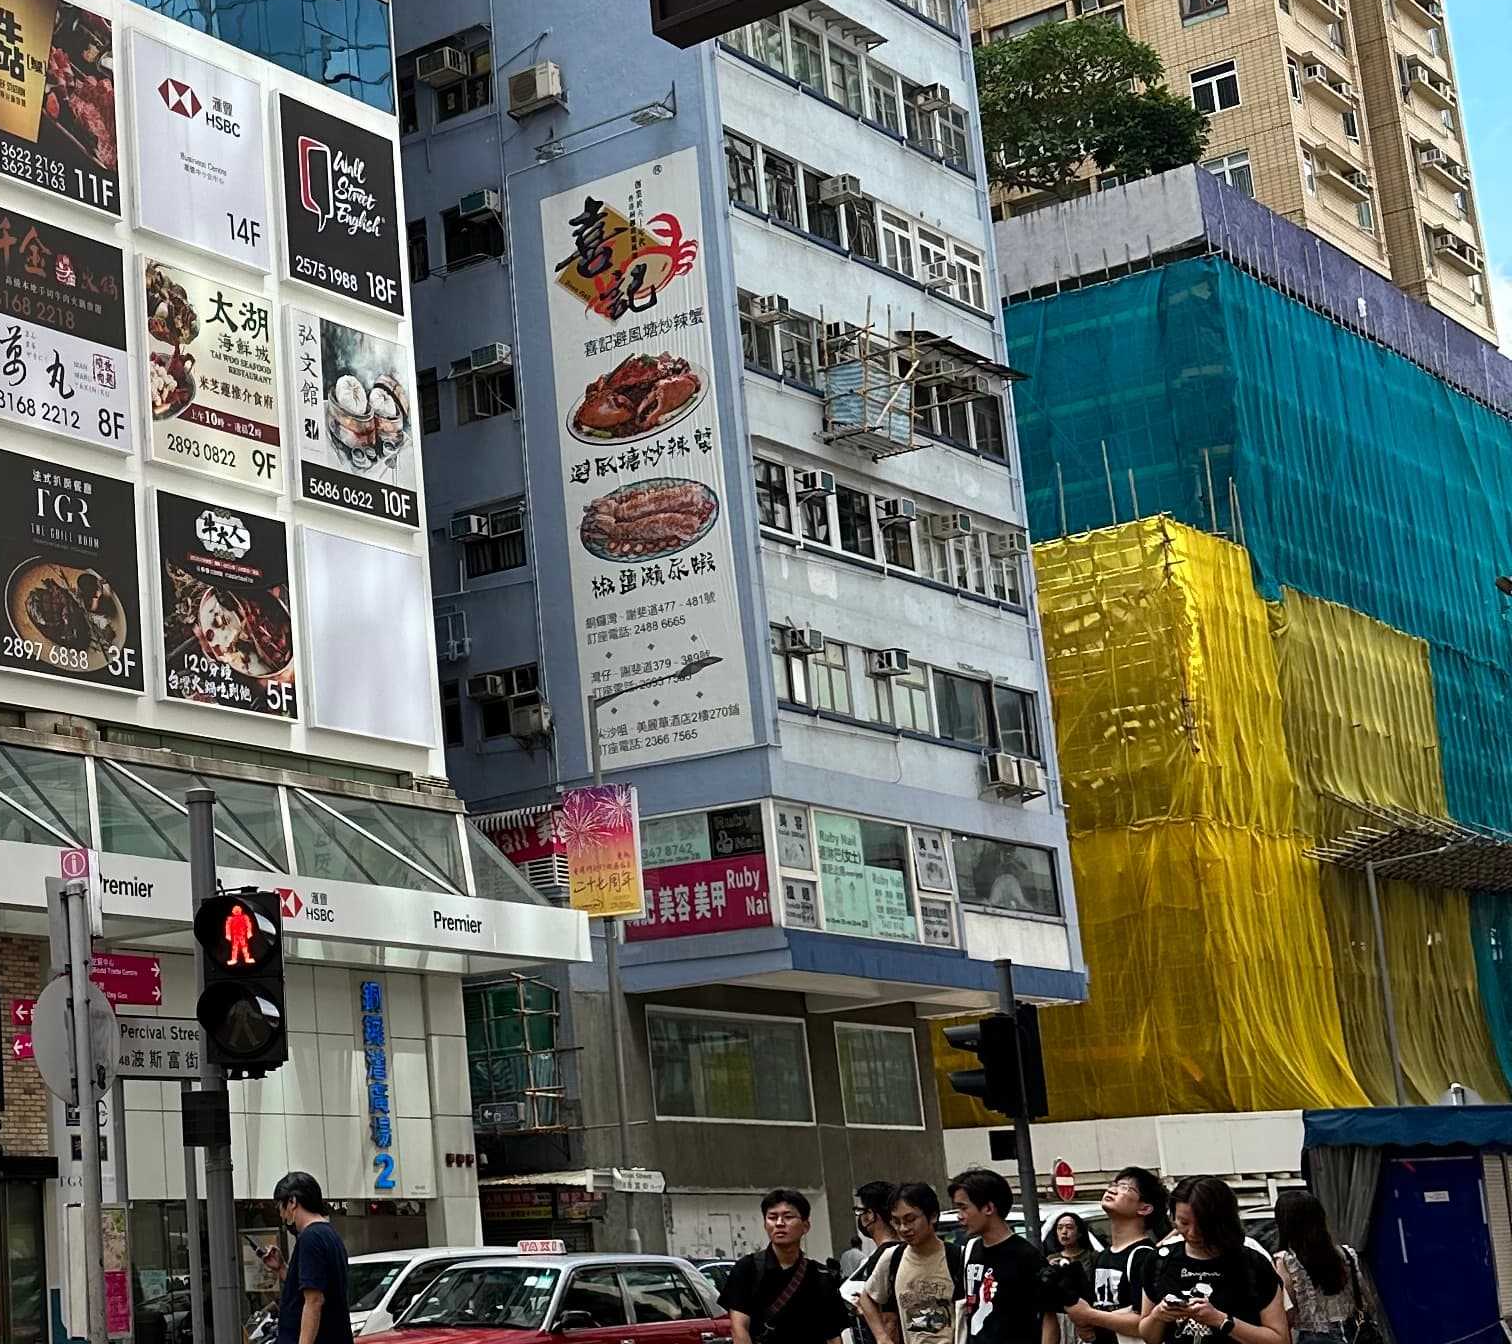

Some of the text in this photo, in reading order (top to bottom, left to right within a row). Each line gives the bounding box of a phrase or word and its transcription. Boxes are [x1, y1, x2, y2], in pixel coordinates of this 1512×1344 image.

[206, 112, 240, 137] HSBC
[1, 141, 31, 165] 3622
[35, 155, 65, 177] 2162
[2, 157, 66, 192] 3622 2163
[334, 151, 365, 183] Wall
[74, 168, 113, 206] 11F
[335, 177, 376, 210] Street
[227, 213, 261, 247] 14F
[336, 203, 382, 237] English
[295, 256, 358, 292] 2575 1988
[555, 196, 657, 320] 喜記
[366, 271, 397, 304] 18F
[38, 306, 75, 329] 2218
[206, 291, 269, 342] 太湖
[584, 307, 705, 357] 喜記避風塘炒辣蟹
[218, 333, 271, 364] 海鮮城
[229, 366, 272, 385] RESTAURANT
[299, 324, 319, 407] 弘文館
[199, 376, 274, 410] 米芝蓮推介食府
[42, 403, 80, 429] 2212
[98, 408, 125, 440] 8F
[167, 434, 236, 468] 2893 0822
[252, 450, 276, 479] 9F
[570, 427, 713, 485] 避風塘炒辣蟹
[38, 488, 91, 527] TGR
[309, 478, 373, 509] 5686 0622
[381, 489, 411, 519] 10F
[202, 513, 246, 549] 牛大人
[634, 620, 658, 635] 2488
[661, 615, 686, 631] 6665
[3, 636, 89, 669] 2897 6838
[108, 645, 136, 678] 3F
[267, 680, 293, 711] 5F
[645, 729, 698, 748] 2366 7565
[99, 873, 153, 898] remier
[574, 870, 635, 893] 二十七周年
[726, 866, 760, 891] Ruby
[305, 907, 335, 924] HSBC
[432, 910, 483, 934] Premier
[120, 1023, 199, 1041] Percival Stree
[132, 1050, 198, 1070] 波斯富街
[520, 1241, 557, 1251] TAXI
